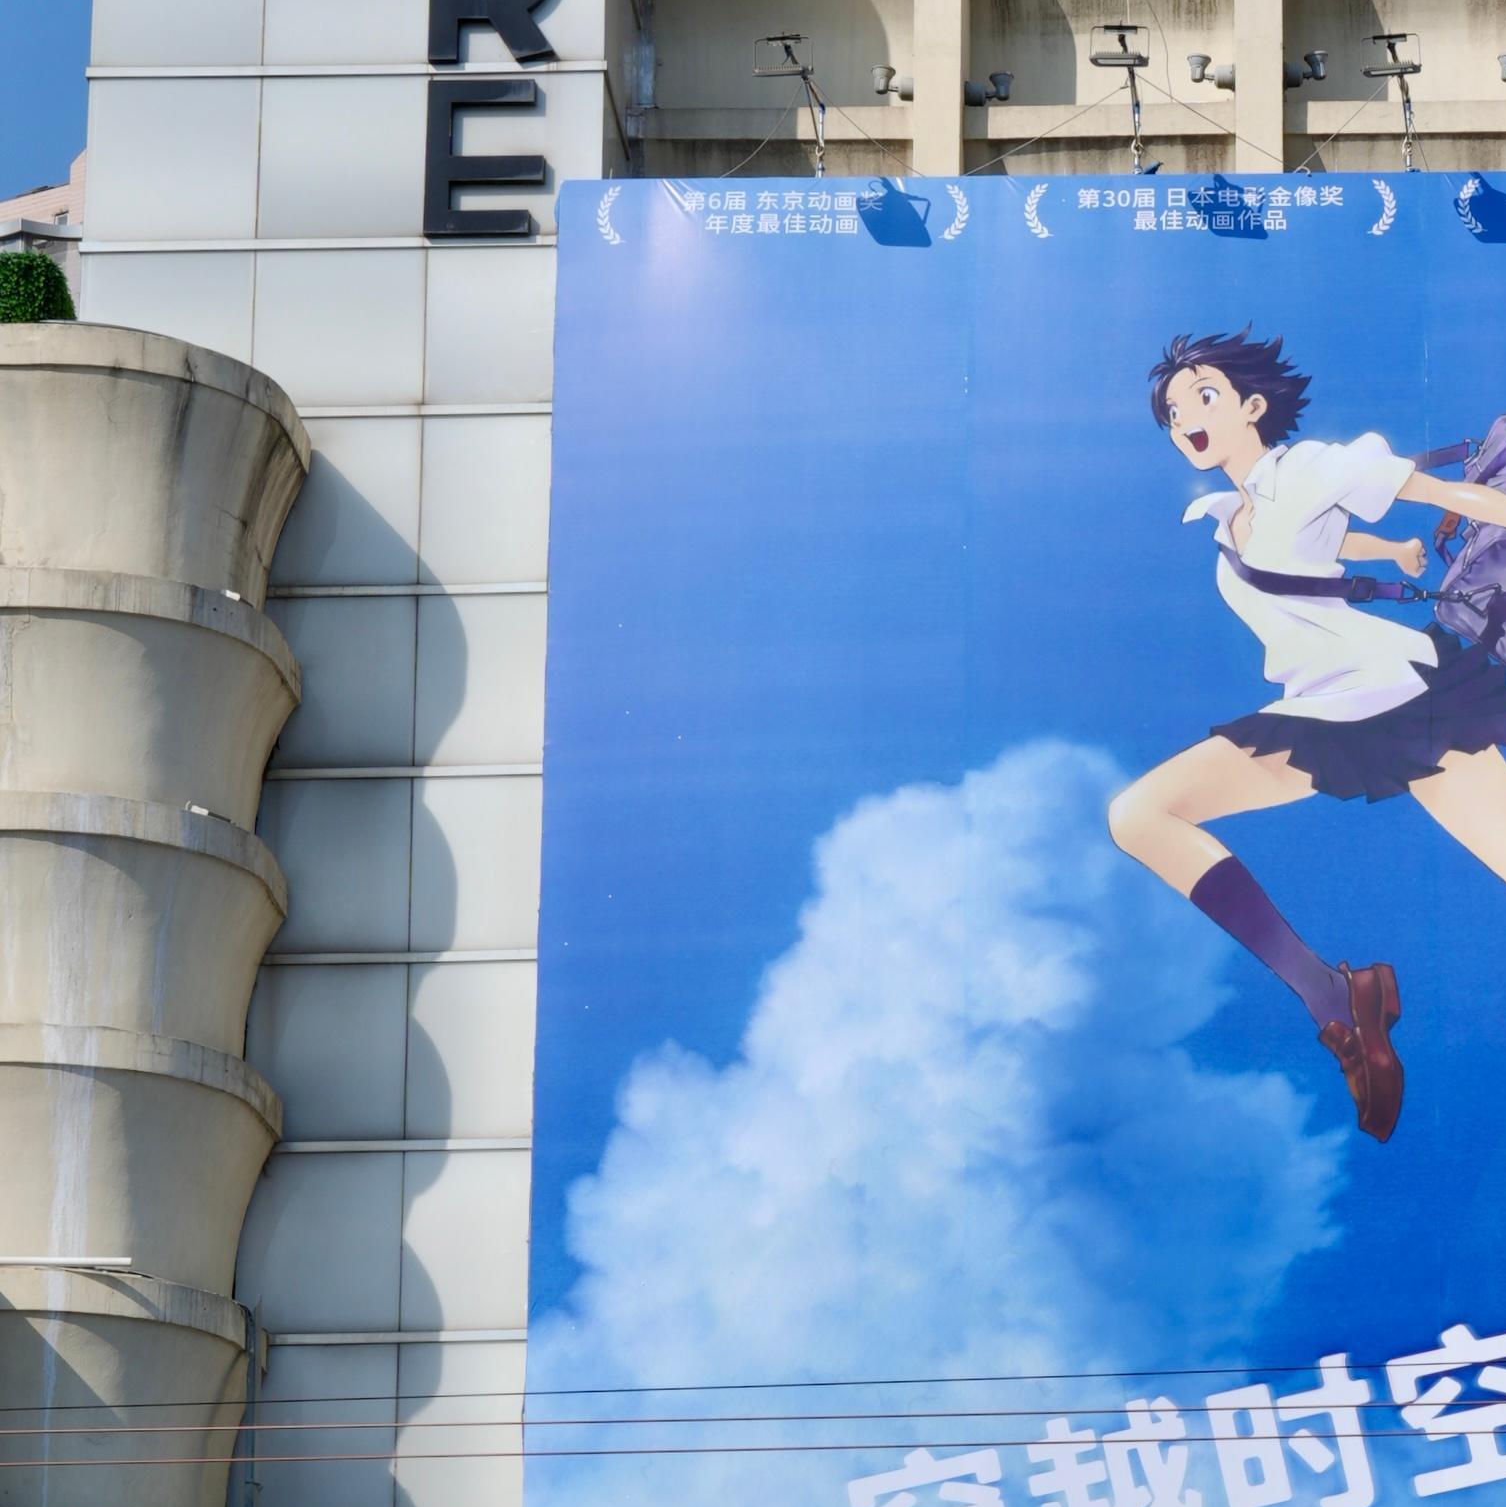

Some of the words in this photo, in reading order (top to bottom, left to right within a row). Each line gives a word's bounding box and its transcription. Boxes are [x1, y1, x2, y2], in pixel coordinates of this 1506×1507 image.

[684, 191, 747, 213] 第6届
[757, 189, 884, 213] 东京动画奖
[1077, 188, 1156, 209] 第30届
[1167, 185, 1345, 208] 日本电影金像奖
[705, 213, 859, 236] 年度最佳动画
[1133, 209, 1288, 232] 最佳动画作品
